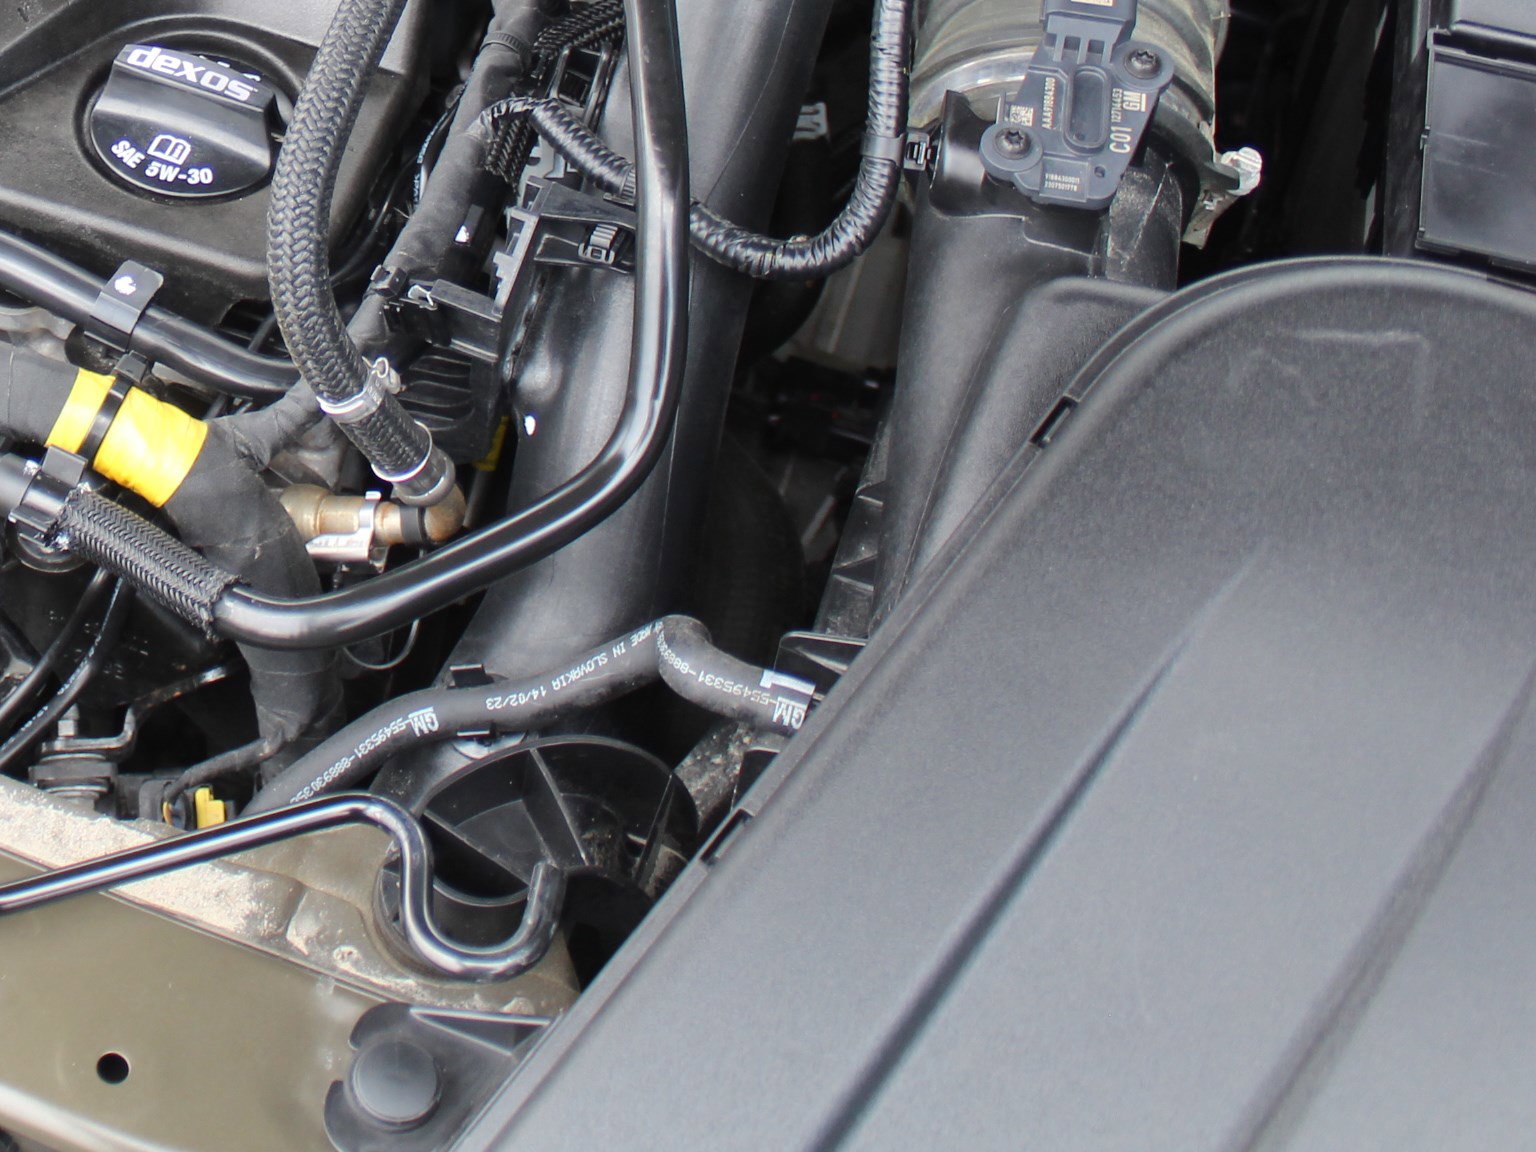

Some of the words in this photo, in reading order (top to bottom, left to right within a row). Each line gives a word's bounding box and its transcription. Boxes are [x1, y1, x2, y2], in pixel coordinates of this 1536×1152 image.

[126, 47, 252, 101] dexos
[1123, 90, 1146, 112] GM
[111, 140, 146, 169] SAE
[145, 161, 214, 185] 5W-30
[613, 641, 627, 659] IN
[551, 652, 608, 690] SLOVAKIA
[485, 685, 547, 710] 14/02/23
[773, 697, 806, 730] GM
[408, 706, 439, 737] GM
